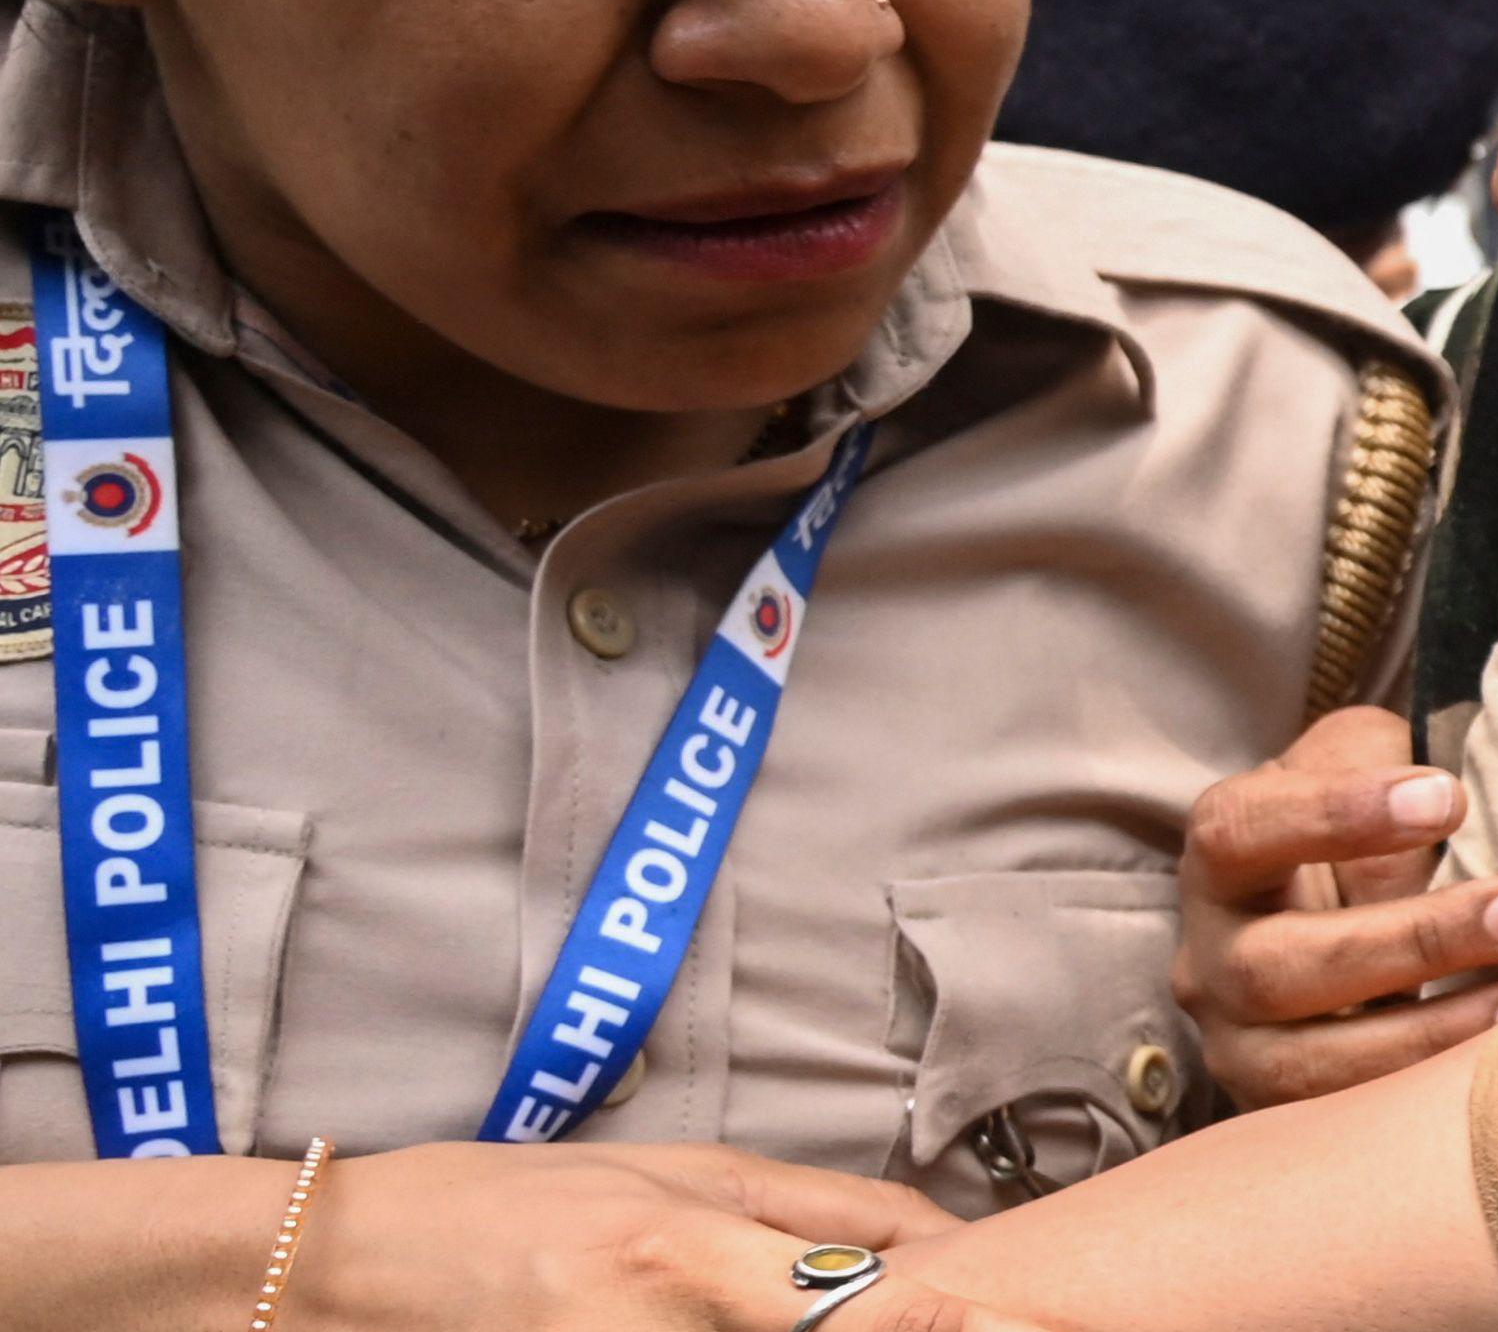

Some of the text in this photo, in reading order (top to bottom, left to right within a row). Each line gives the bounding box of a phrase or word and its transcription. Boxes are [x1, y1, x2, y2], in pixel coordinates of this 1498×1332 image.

[82, 599, 168, 907] POLICE
[504, 684, 757, 1143] ELHI POLICE
